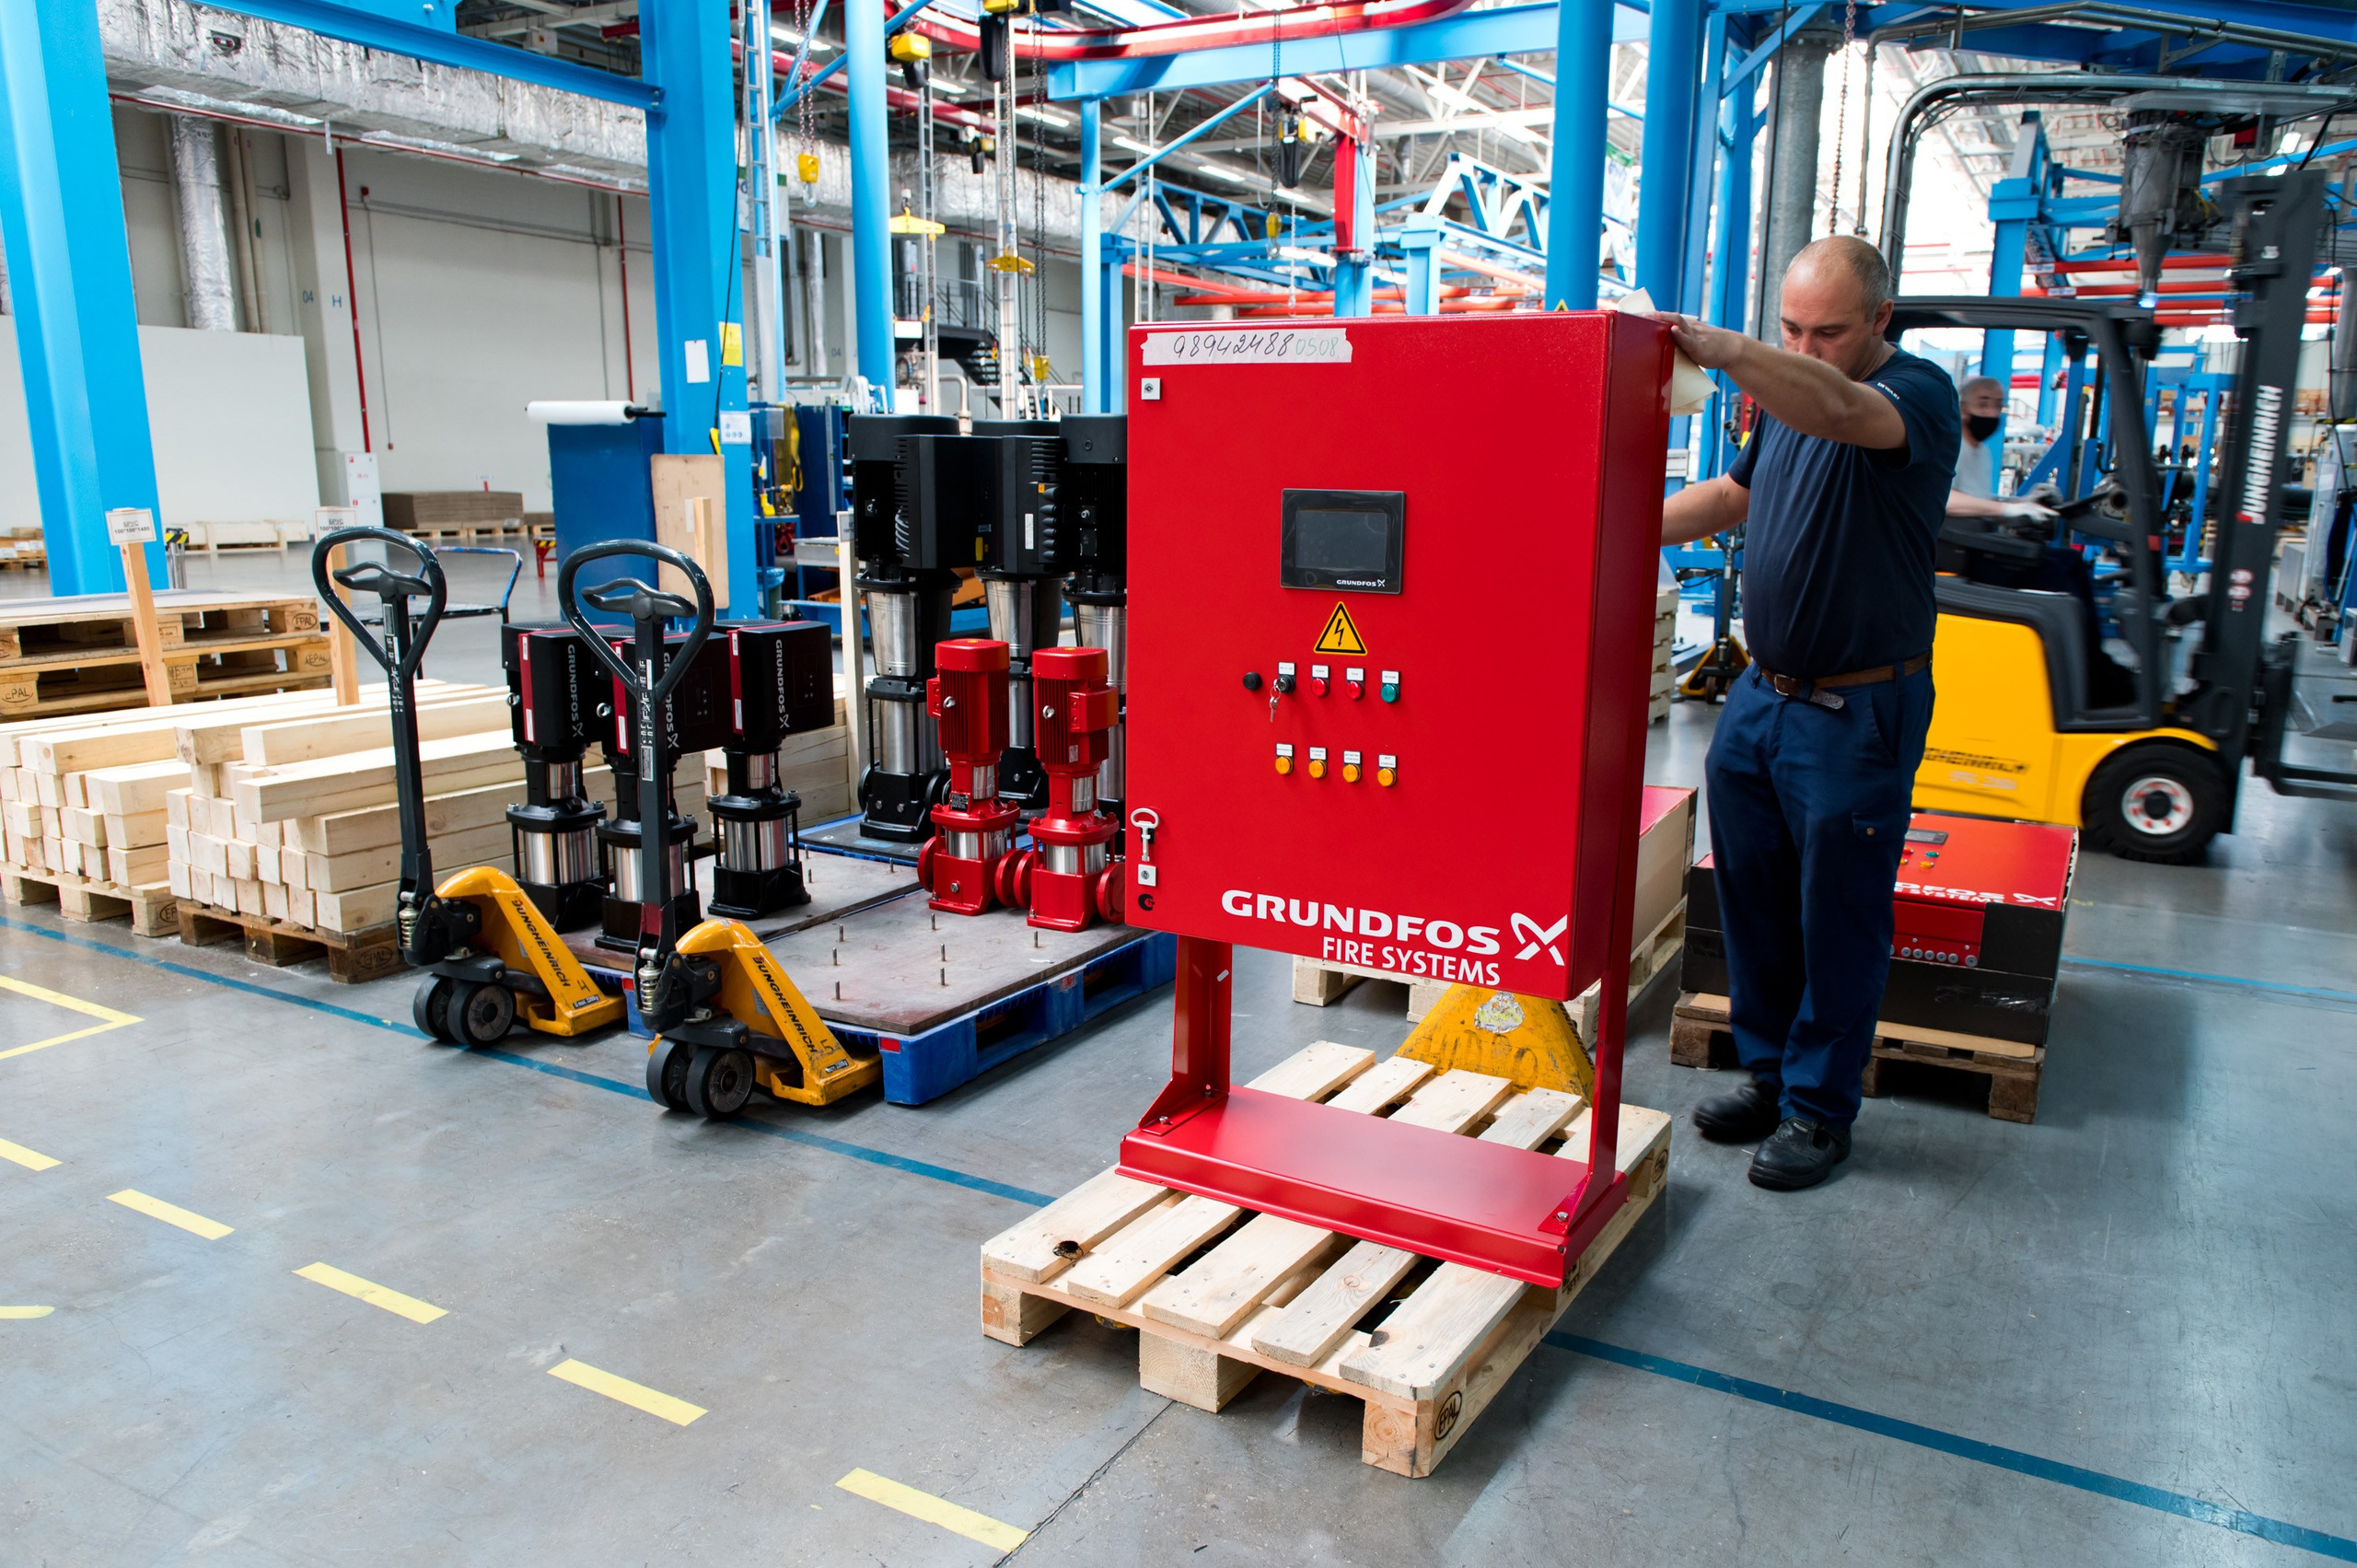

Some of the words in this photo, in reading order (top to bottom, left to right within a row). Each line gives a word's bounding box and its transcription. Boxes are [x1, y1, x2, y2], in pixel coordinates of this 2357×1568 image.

[303, 290, 314, 304] 04
[331, 294, 342, 308] H
[1173, 331, 1295, 358] 98942488
[2237, 385, 2283, 525] JUNGHEINRICH
[1336, 579, 1377, 587] GRUNDFOS
[567, 645, 579, 722] GRUNDFOS
[775, 639, 785, 714] GRUNDFOS
[512, 897, 571, 987] JUNGHEINRICH
[1221, 889, 1501, 955] GRUNDFOS
[1323, 936, 1374, 966] FIRE
[1382, 946, 1501, 986] SYSTEMS
[752, 955, 818, 1053] JUNGHEINRICH
[1438, 1398, 1457, 1435] EPAL
